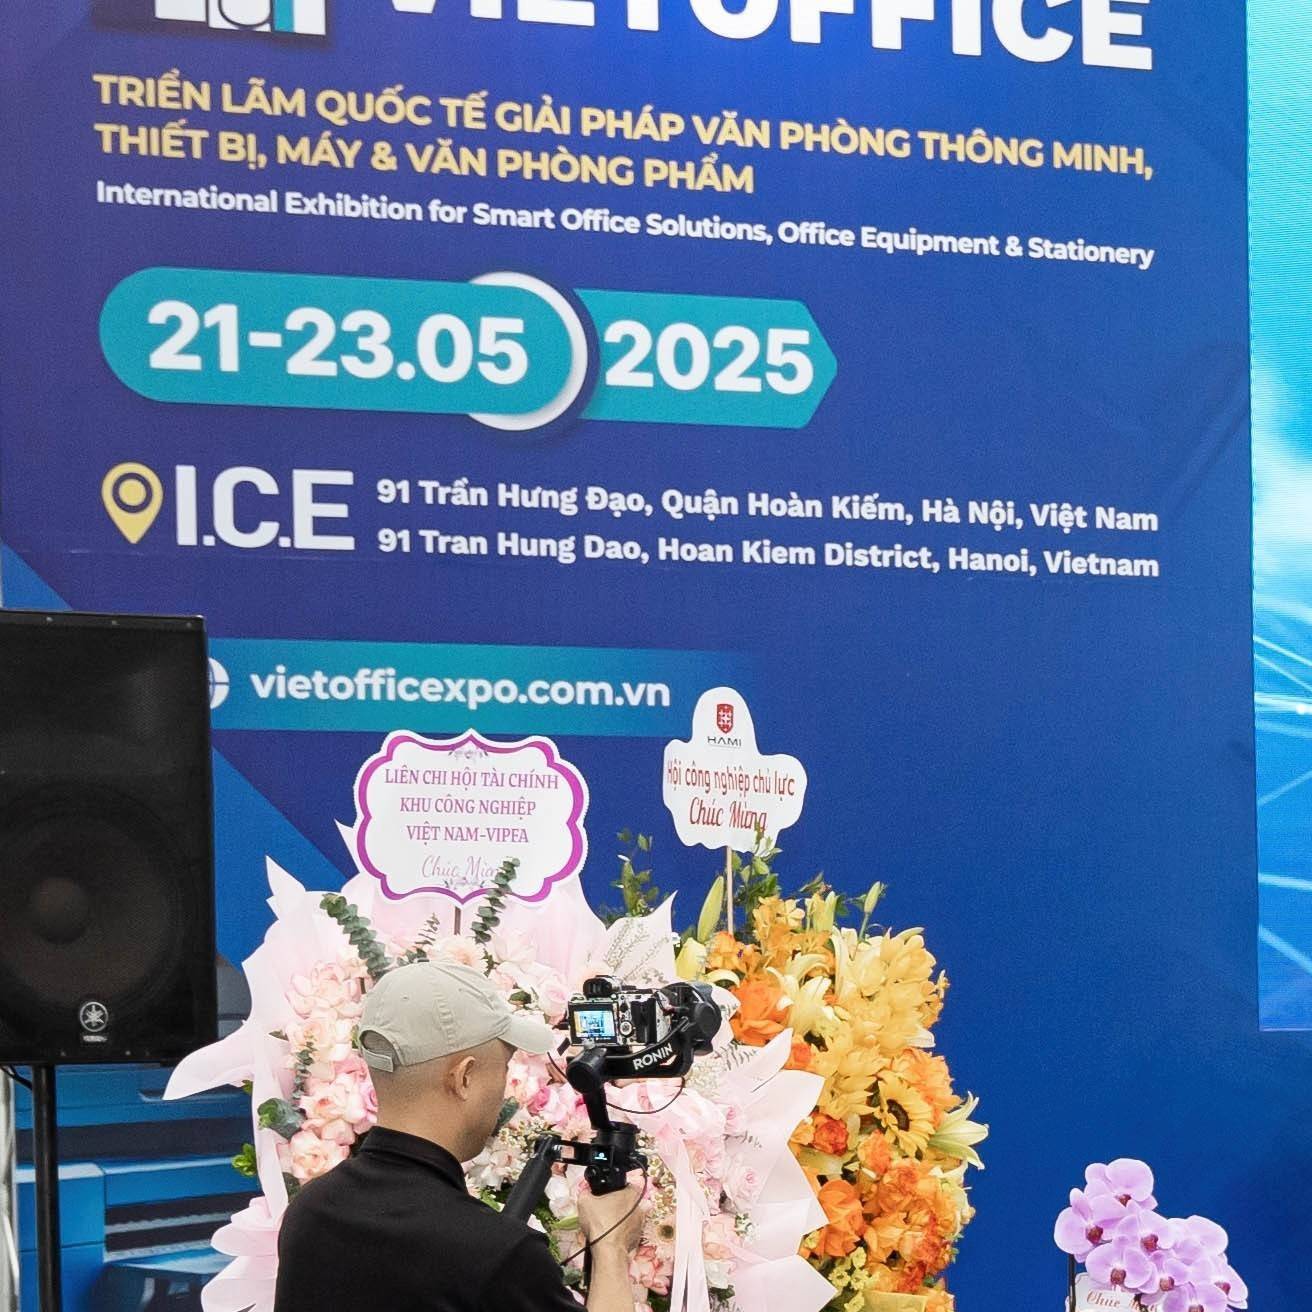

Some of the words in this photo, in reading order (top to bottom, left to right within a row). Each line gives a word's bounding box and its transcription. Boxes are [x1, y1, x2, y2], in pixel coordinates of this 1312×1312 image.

[389, 0, 1154, 71] FFICE
[93, 69, 210, 111] TRIỂN
[222, 77, 306, 118] LÃM
[316, 85, 432, 128] QUỐC
[439, 90, 490, 130] TẾ
[495, 94, 571, 135] GIẢI
[581, 104, 685, 143] PHÁP
[692, 110, 770, 150] VĂN
[780, 117, 911, 159] PHÒNG
[918, 128, 1044, 169] THÔNG
[1052, 141, 1155, 181] MINH,
[94, 118, 209, 160] THIẾT
[219, 132, 268, 170] BỊ,
[277, 131, 363, 169] MÁY
[370, 140, 398, 172] &
[404, 137, 486, 178] VĂN
[497, 145, 635, 186] PHÒNG
[644, 152, 755, 194] PHẨM
[96, 180, 277, 213] International
[286, 191, 423, 222] Exhibition
[428, 199, 468, 223] for
[472, 203, 555, 229] Smart
[561, 207, 641, 235] Office
[646, 213, 774, 246] Solutions,
[778, 221, 855, 247] Office
[861, 226, 1000, 256] Equipment
[1005, 236, 1021, 256] &
[1028, 236, 1156, 270] Stationery
[147, 299, 529, 385] 21-23.05
[602, 320, 815, 396] 2025
[175, 464, 355, 550] I.C.E
[376, 478, 410, 504] 91
[419, 477, 488, 508] Trần
[497, 483, 578, 515] Hưng
[585, 487, 653, 518] Đạo,
[662, 488, 739, 522] Quận
[748, 491, 822, 520] Hoàn
[832, 493, 914, 526] Kiếm,
[922, 497, 961, 525] Hà
[968, 499, 1024, 532] Nội,
[1029, 502, 1088, 535] Việt
[1095, 506, 1159, 532] Nam
[377, 527, 411, 554] 91
[420, 529, 488, 557] Tran
[497, 531, 577, 564] Hung
[585, 534, 650, 564] Dao,
[658, 536, 733, 563] Hoan
[742, 538, 816, 565] Kiem
[825, 541, 940, 573] District,
[949, 547, 1037, 577] Hanoi,
[1044, 550, 1160, 577] Vietnam
[250, 665, 671, 711] vietofficexpo.com.vn
[385, 765, 419, 785] LIÊN
[422, 769, 447, 785] CHI
[451, 767, 477, 791] HỘI
[480, 767, 505, 787] TÀI
[508, 769, 559, 789] CHÍNH
[685, 760, 711, 795] công
[714, 765, 750, 798] nghiệp
[400, 797, 432, 813] KHU
[435, 794, 476, 814] CÔNG
[478, 796, 536, 821] NGHIỆP
[689, 797, 724, 827] Chúc
[405, 820, 441, 846] VIỆT
[632, 1043, 673, 1071] RONIN
